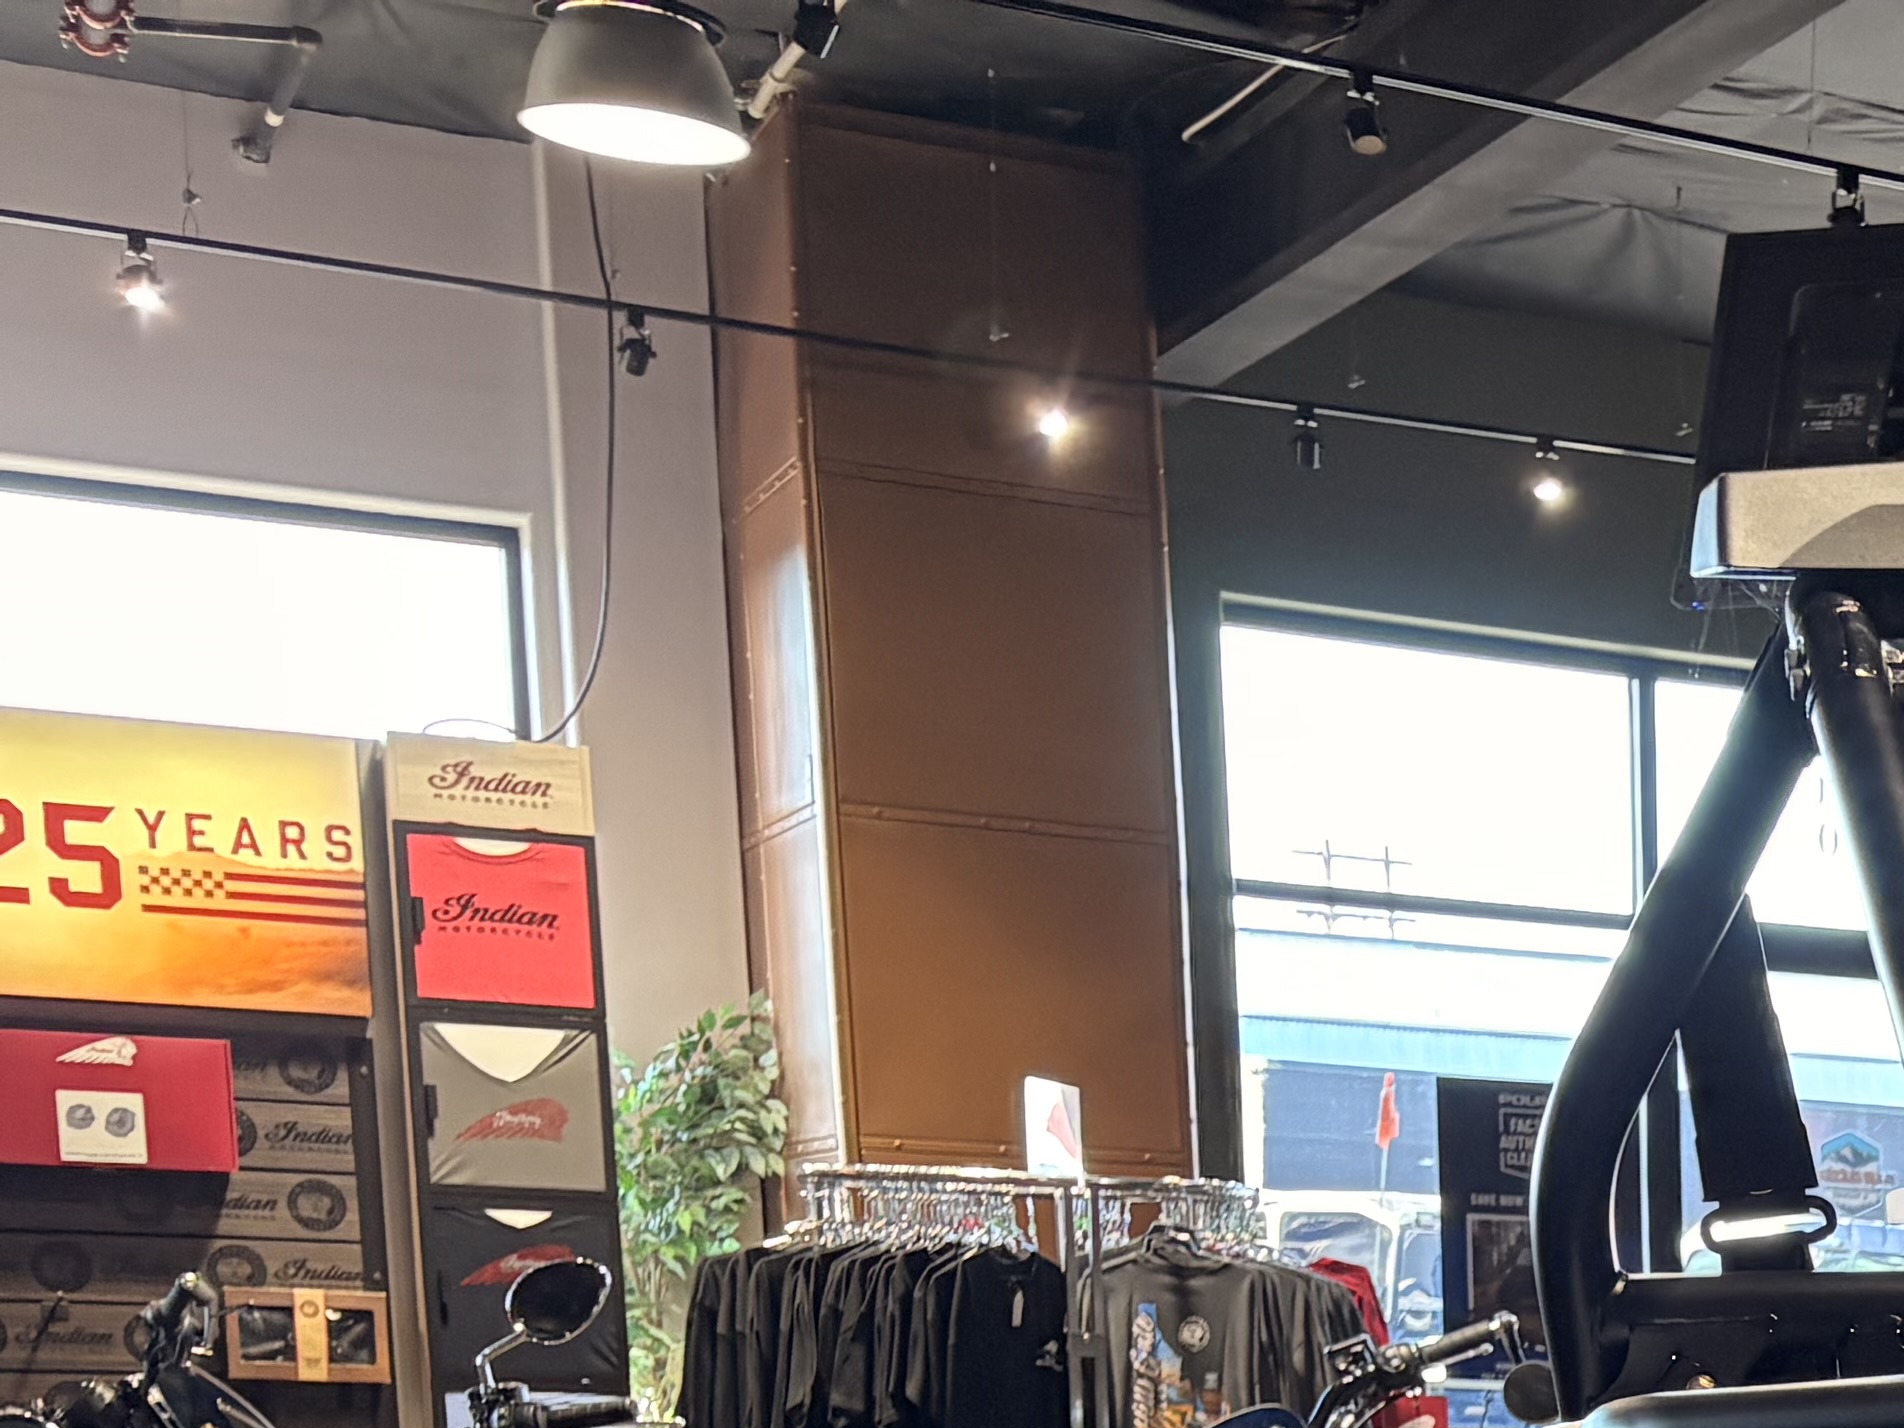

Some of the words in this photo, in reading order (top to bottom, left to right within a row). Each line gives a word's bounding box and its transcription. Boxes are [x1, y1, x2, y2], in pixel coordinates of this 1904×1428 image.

[428, 761, 553, 798] Indian
[433, 793, 550, 809] MOTORCYCLE
[135, 807, 352, 863] YEARS
[432, 893, 559, 930] Indian
[438, 926, 556, 941] MOTORCYCLE
